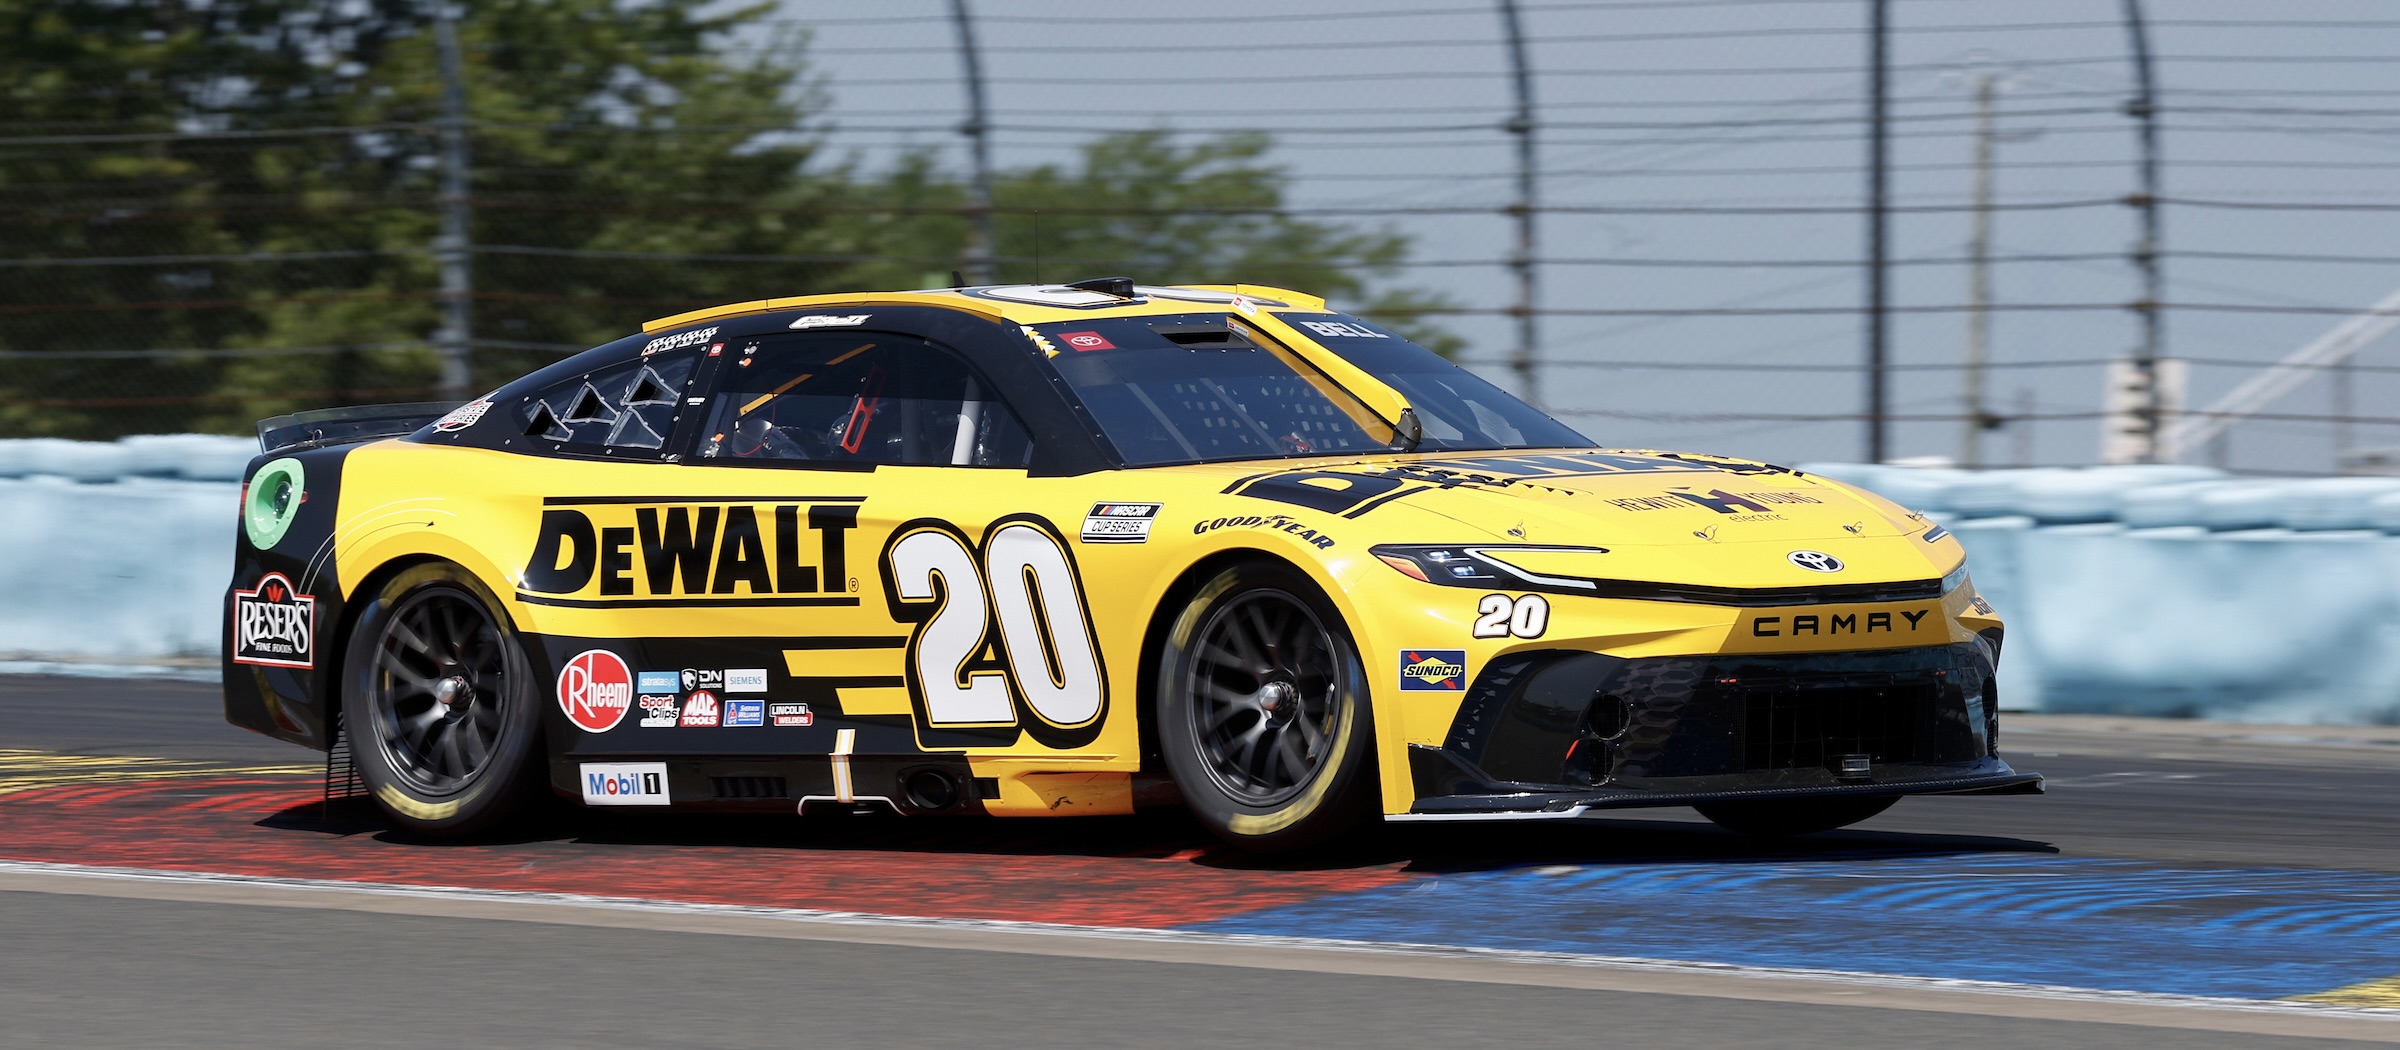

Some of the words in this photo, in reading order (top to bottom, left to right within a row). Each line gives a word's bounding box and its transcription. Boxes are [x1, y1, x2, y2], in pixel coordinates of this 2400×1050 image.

[1299, 321, 1390, 339] BELL
[1603, 495, 1697, 512] HEWITT
[1737, 492, 1824, 504] YOUNG
[1110, 505, 1152, 516] NASCAR
[1729, 513, 1789, 523] electric
[1091, 520, 1111, 533] CUP
[1111, 520, 1143, 533] SERIES
[1193, 515, 1335, 550] GOODYEAR
[517, 505, 862, 596] DEWALT
[1472, 593, 1550, 640] 20
[1752, 609, 1929, 637] CAMRY
[239, 600, 309, 655] RESER'S
[879, 512, 1110, 750] 20
[255, 641, 272, 652] FINE
[272, 643, 293, 654] FOODS
[698, 669, 723, 683] DN
[1404, 665, 1460, 677] SUNOCO
[568, 653, 627, 719] Rheem
[641, 676, 677, 688] stratasys
[729, 676, 763, 686] SIEMENS
[641, 695, 674, 709] Sport
[651, 707, 678, 720] Clips
[771, 706, 805, 716] LINCOLN
[683, 715, 717, 726] TOOLS
[778, 716, 808, 725] WELDERS
[588, 772, 640, 796] Mobil
